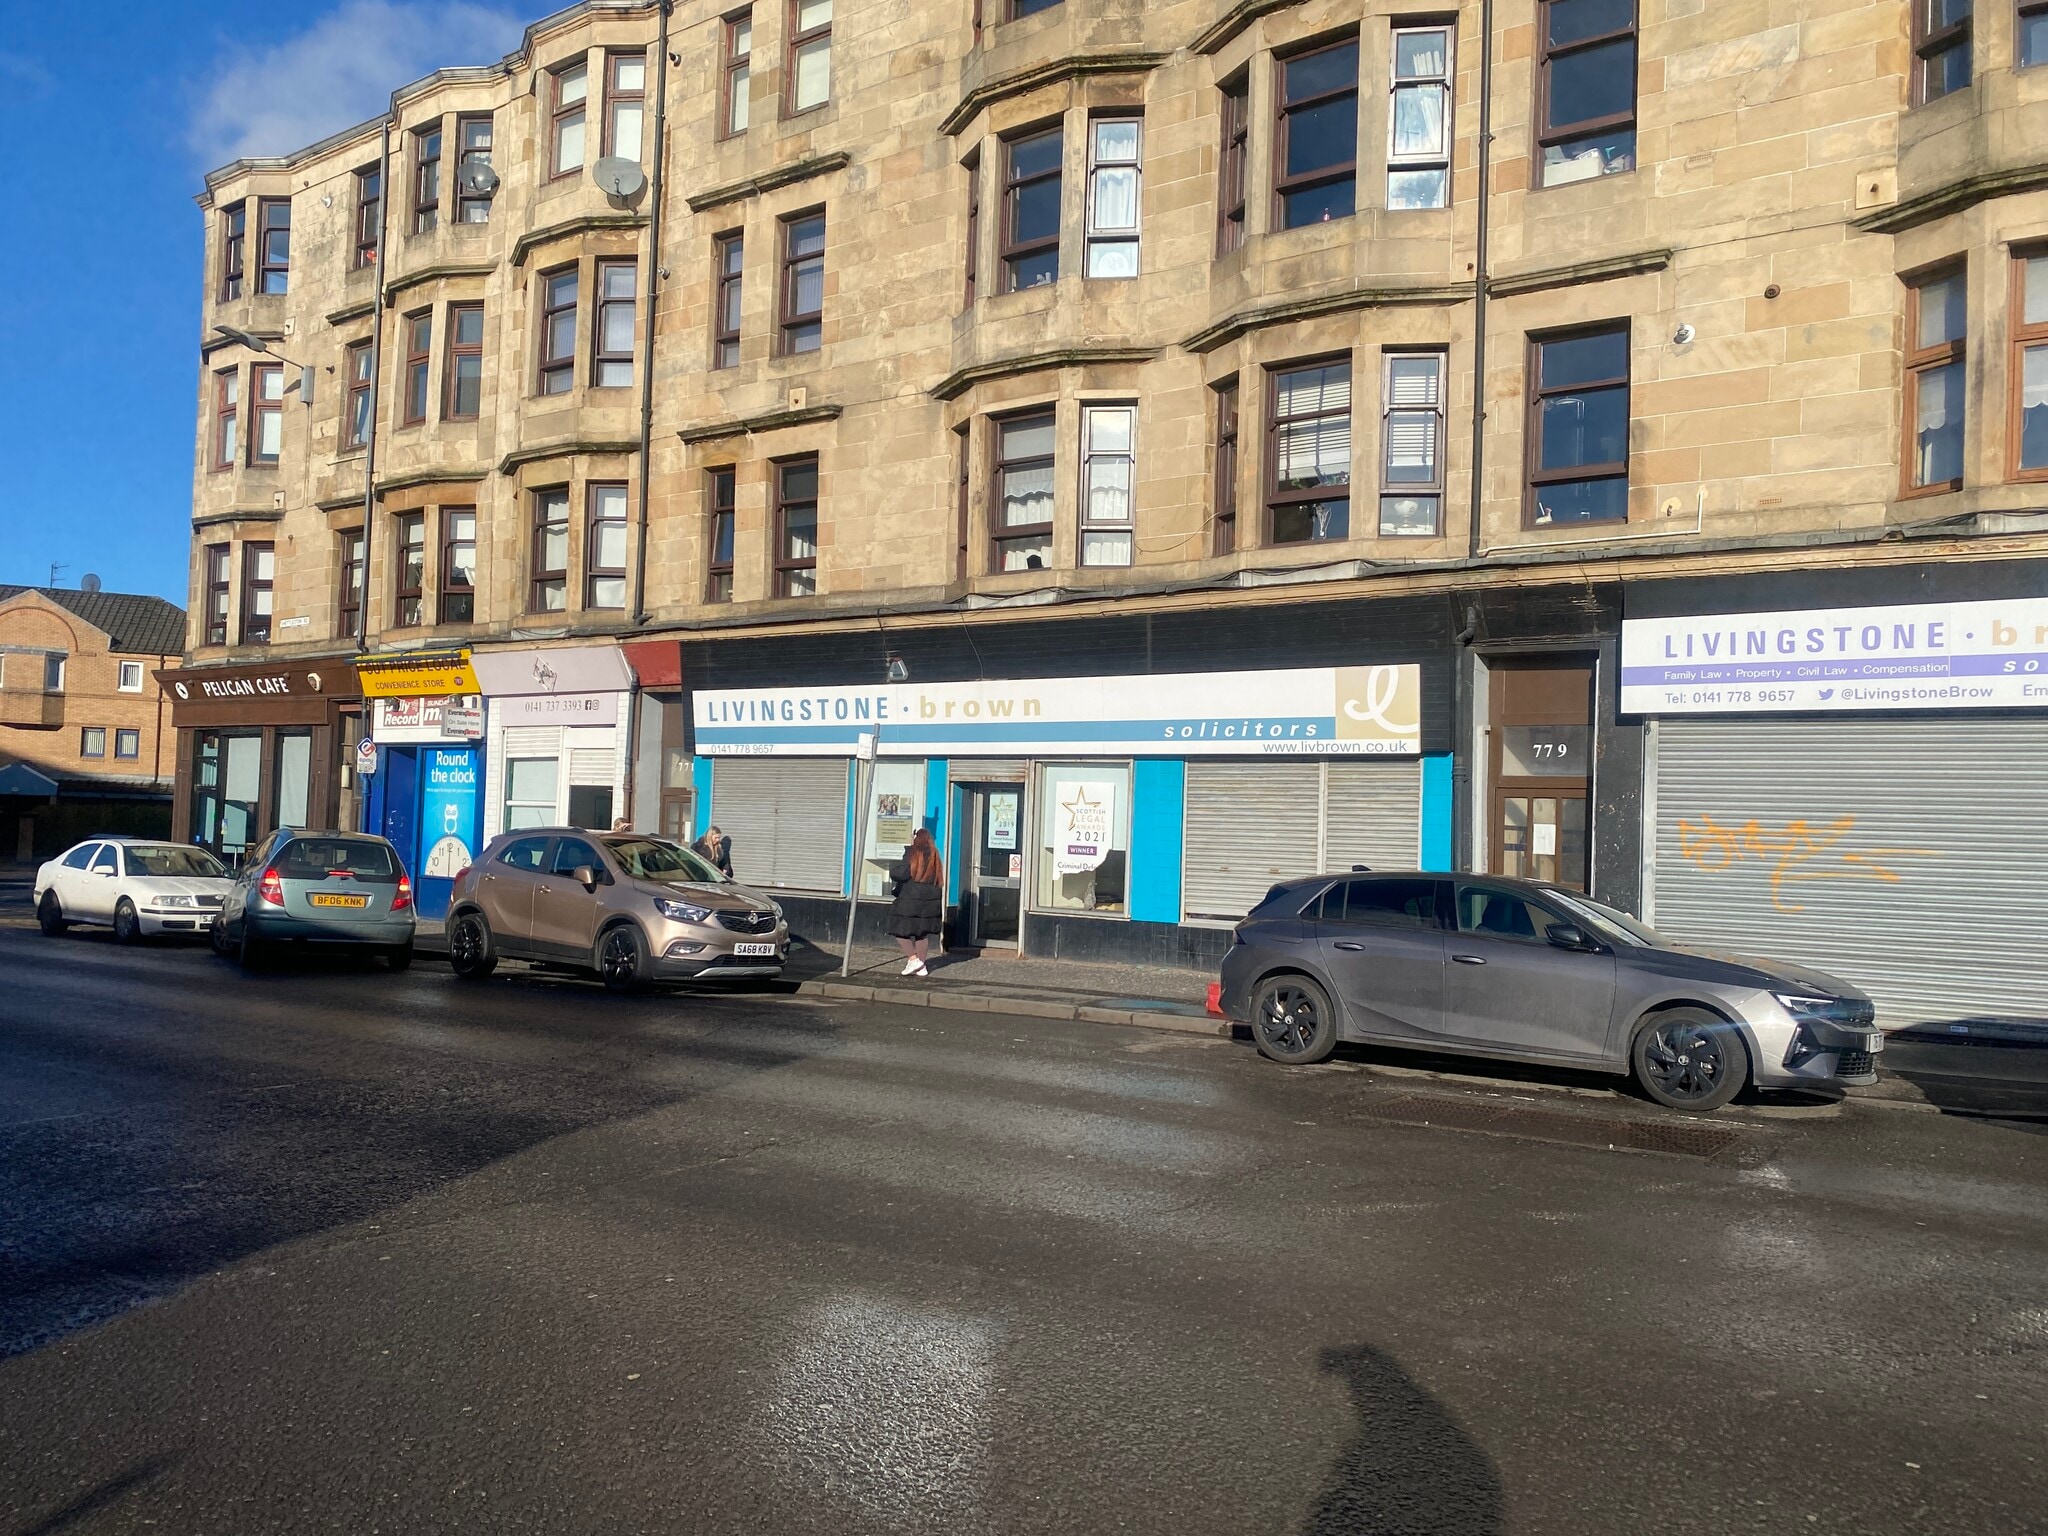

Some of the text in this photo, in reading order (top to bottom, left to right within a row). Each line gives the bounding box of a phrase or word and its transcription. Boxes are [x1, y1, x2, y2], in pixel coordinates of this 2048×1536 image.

[1665, 622, 1945, 658] LIVINGSTONE
[1664, 662, 1949, 681] Family Law Property Civil Law Compensation
[202, 677, 290, 697] PELICAN CAFE
[375, 680, 420, 690] CONVENIENCE
[423, 679, 446, 688] STORE
[1665, 690, 1795, 704] Tel: 0141 778 9657
[1841, 685, 1993, 701] @LivingstoneBrow
[525, 700, 582, 712] 0141 737 3393
[708, 695, 1041, 722] LIVINGSTONE brown
[384, 711, 420, 726] Record
[1164, 720, 1319, 739] solicitors
[711, 744, 774, 754] 0141 778 9657
[1262, 740, 1408, 754] www.livbrown.co.uk
[1532, 743, 1568, 758] 779
[436, 750, 469, 766] Round
[431, 768, 476, 783] the clock
[1076, 815, 1106, 823] LEGAL
[1076, 831, 1106, 842] 2021
[1070, 847, 1095, 855] WINNER
[1057, 861, 1082, 870] Criminal
[317, 895, 362, 906] BF06 KNK
[737, 944, 757, 953] SA68
